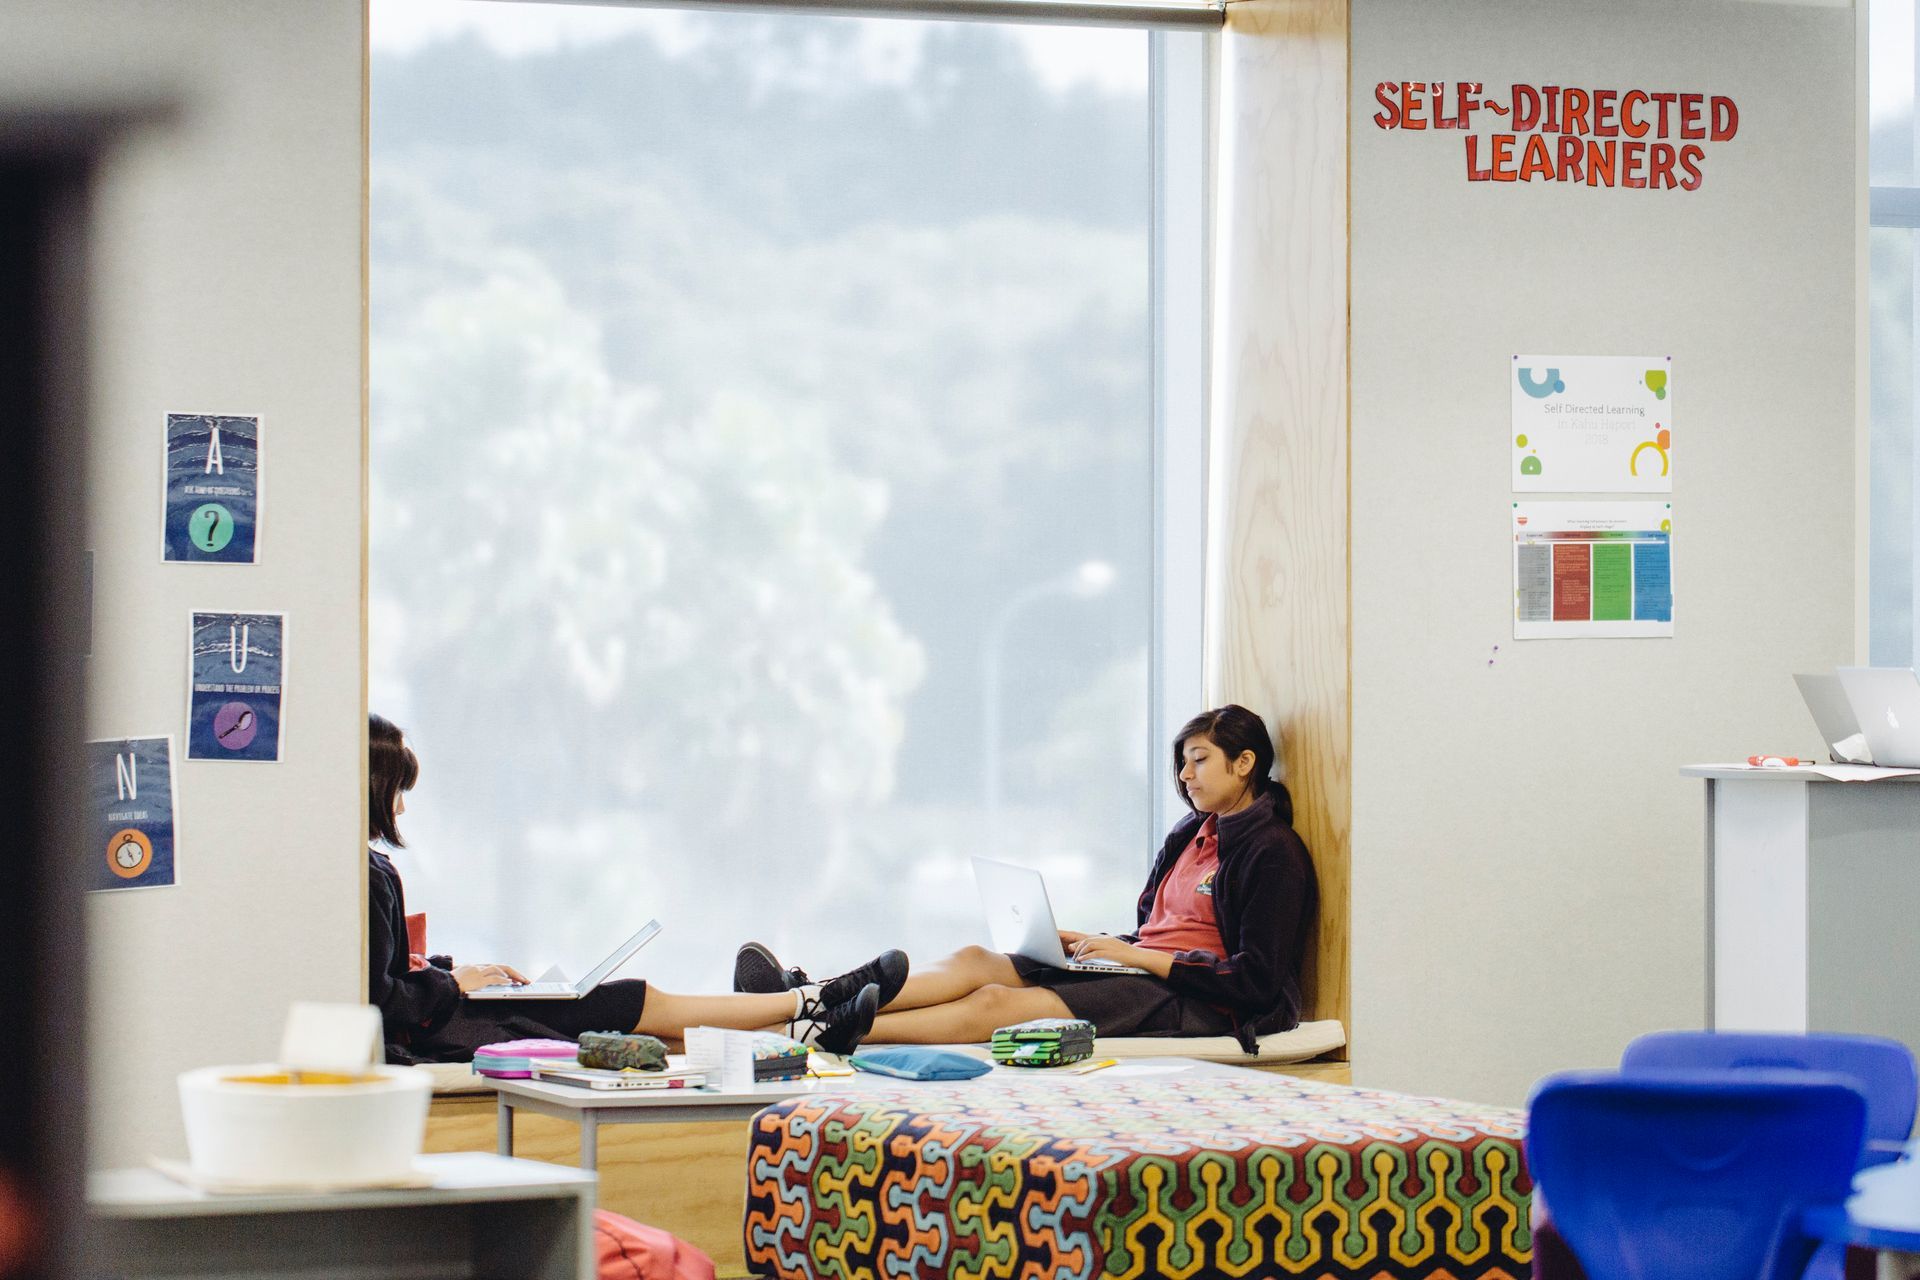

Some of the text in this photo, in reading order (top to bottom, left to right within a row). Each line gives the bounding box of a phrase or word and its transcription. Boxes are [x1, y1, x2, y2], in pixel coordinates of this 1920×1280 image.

[1465, 134, 1707, 191] LEARNERS
[1544, 403, 1646, 418] Self Directed Learning
[205, 427, 224, 476] A
[231, 624, 249, 673] U
[116, 752, 137, 801] N
